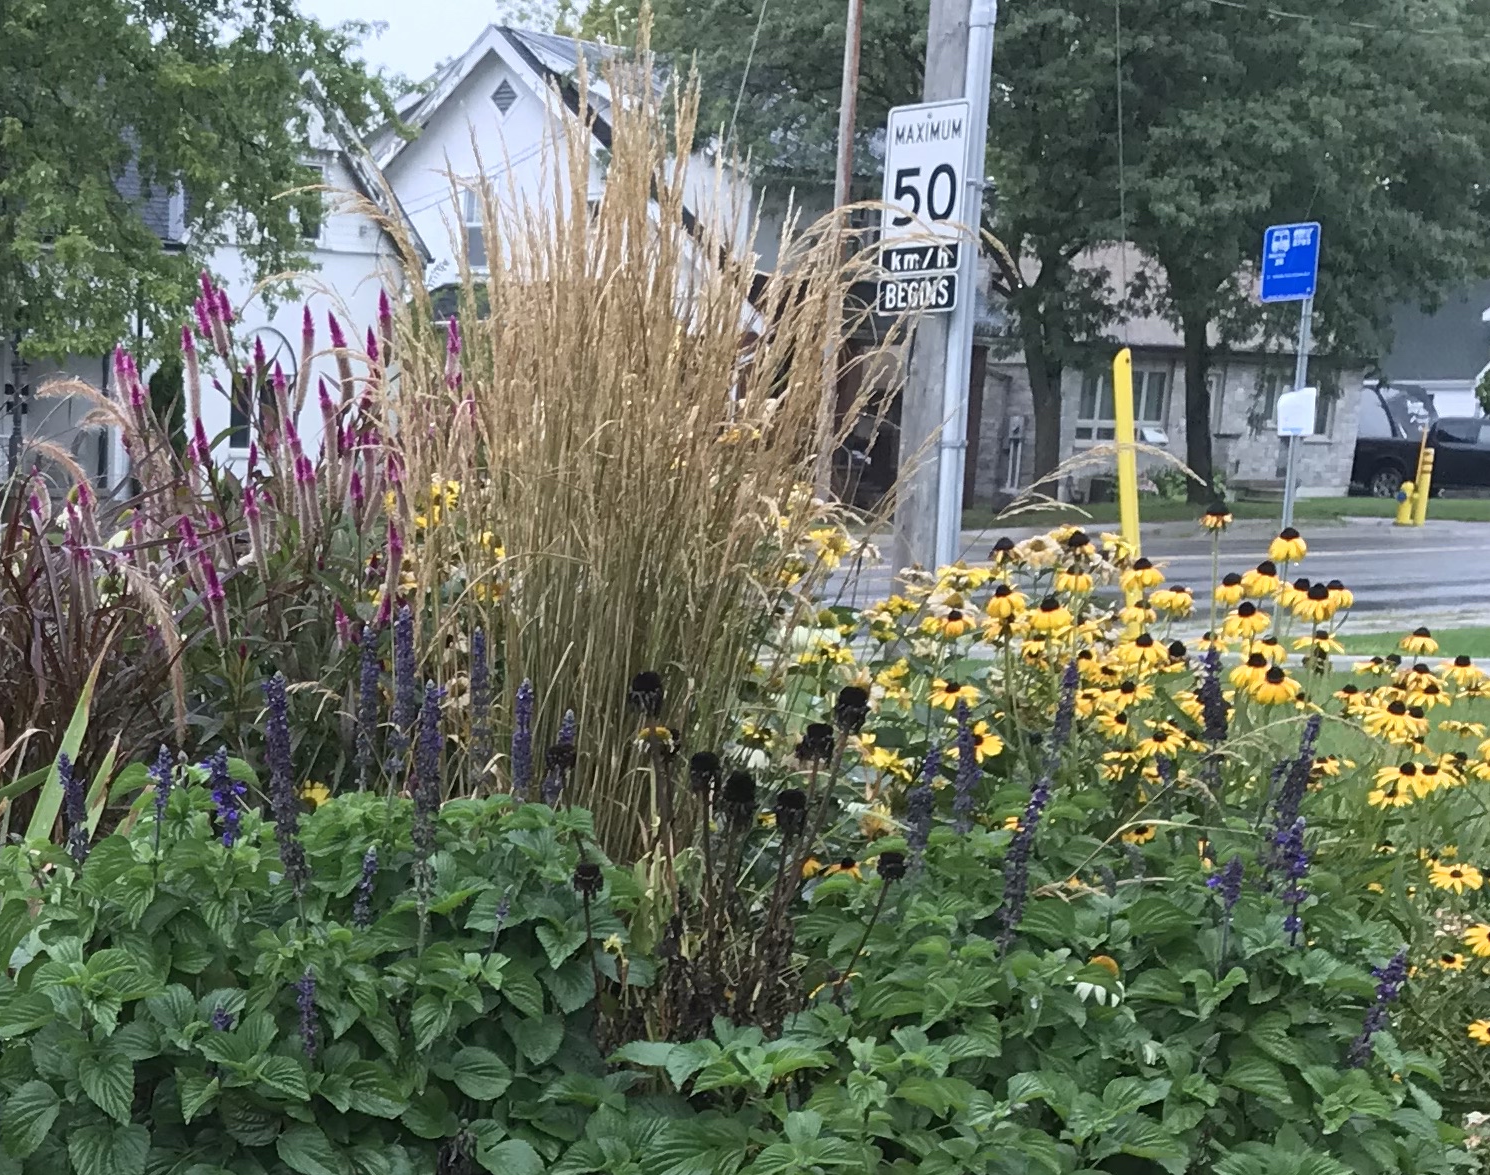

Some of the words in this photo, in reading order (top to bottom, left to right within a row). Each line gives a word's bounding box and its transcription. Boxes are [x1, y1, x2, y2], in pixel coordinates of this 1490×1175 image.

[894, 118, 963, 146] MAXIMUM
[892, 163, 957, 227] 50
[890, 247, 948, 271] km/h
[885, 279, 949, 309] BEGINS
